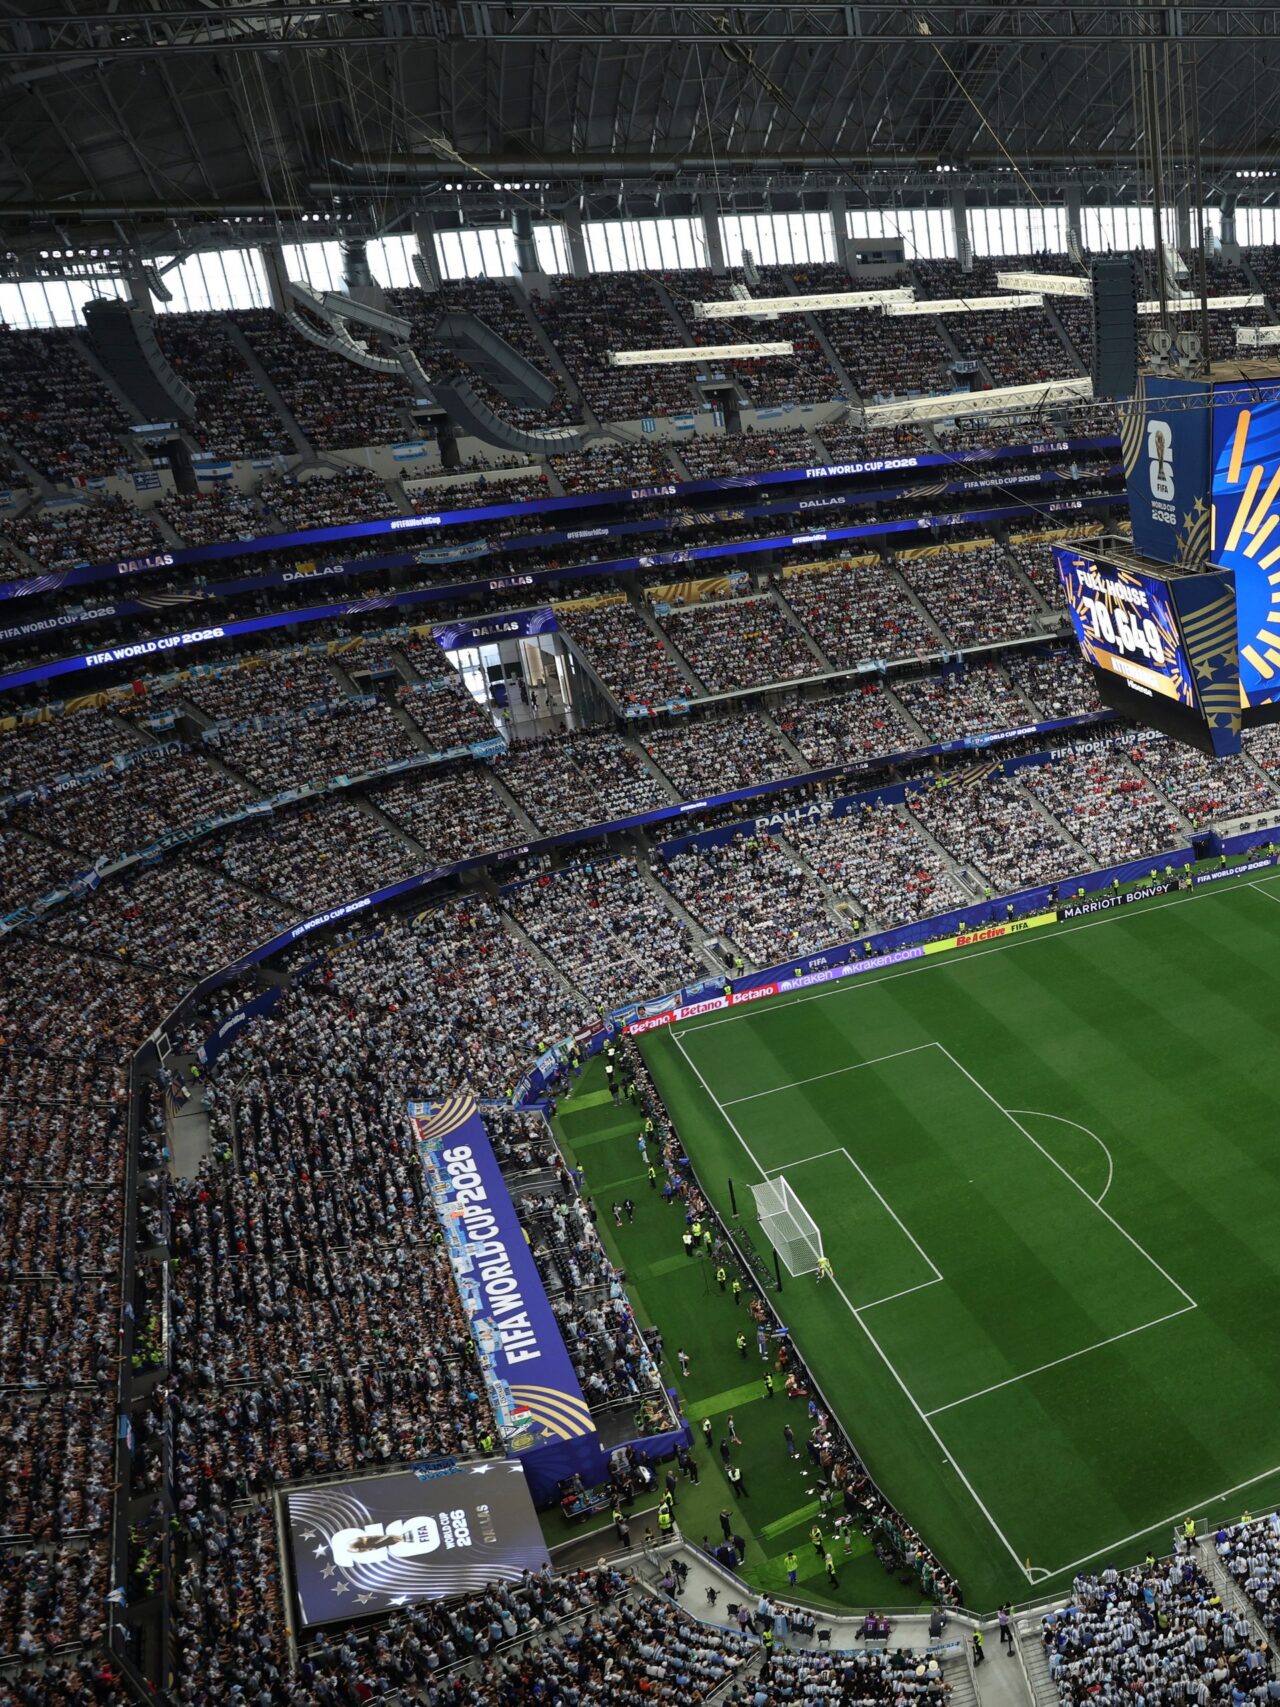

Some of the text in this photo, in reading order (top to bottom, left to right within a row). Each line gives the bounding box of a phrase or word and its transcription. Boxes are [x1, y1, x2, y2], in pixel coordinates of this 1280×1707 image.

[1032, 442, 1069, 454] DALLAS
[806, 457, 918, 478] FIFA WORLD CUP 2026
[964, 474, 1041, 489] FIFA WORLD CUP 2026
[1157, 483, 1168, 493] FIFA
[631, 485, 677, 499] DALLAS
[799, 497, 846, 509] DALLAS
[1050, 501, 1082, 511] DALLAS
[1151, 500, 1166, 510] WORLD
[1152, 509, 1176, 525] 2026
[117, 554, 173, 573] DALLAS
[283, 565, 344, 582] DALLAS
[489, 575, 534, 590] DALLAS
[1076, 569, 1149, 609] FULL HOUSE
[20, 617, 57, 635] WORLD
[80, 606, 115, 621] 2026
[472, 622, 519, 637] DALLAS
[1082, 596, 1165, 664] 70,649
[86, 628, 224, 666] FIFA WORLD CUP 2026
[1004, 726, 1036, 739] CUP 2026
[1051, 746, 1074, 760] FIFA
[1114, 735, 1135, 747] CUP
[843, 763, 869, 773] DALLAS
[497, 846, 529, 860] DALLAS
[1197, 859, 1269, 884] FIFA WORLD CUP 2026
[1064, 883, 1169, 920] MARRIOTT BONVOY
[291, 898, 371, 938] FIFA WORLD CUP 2026
[1011, 921, 1029, 932] FIFA
[956, 926, 1006, 948] Be Active
[808, 956, 828, 969] FIFA
[629, 985, 774, 1036] Betano Betano Betano
[442, 1144, 541, 1365] FIFA WORLD CUP 2026
[438, 1512, 454, 1550] WORLD CUP
[450, 1509, 472, 1547] 2026
[475, 1504, 497, 1544] DALLAS
[419, 1525, 430, 1543] FIFA
